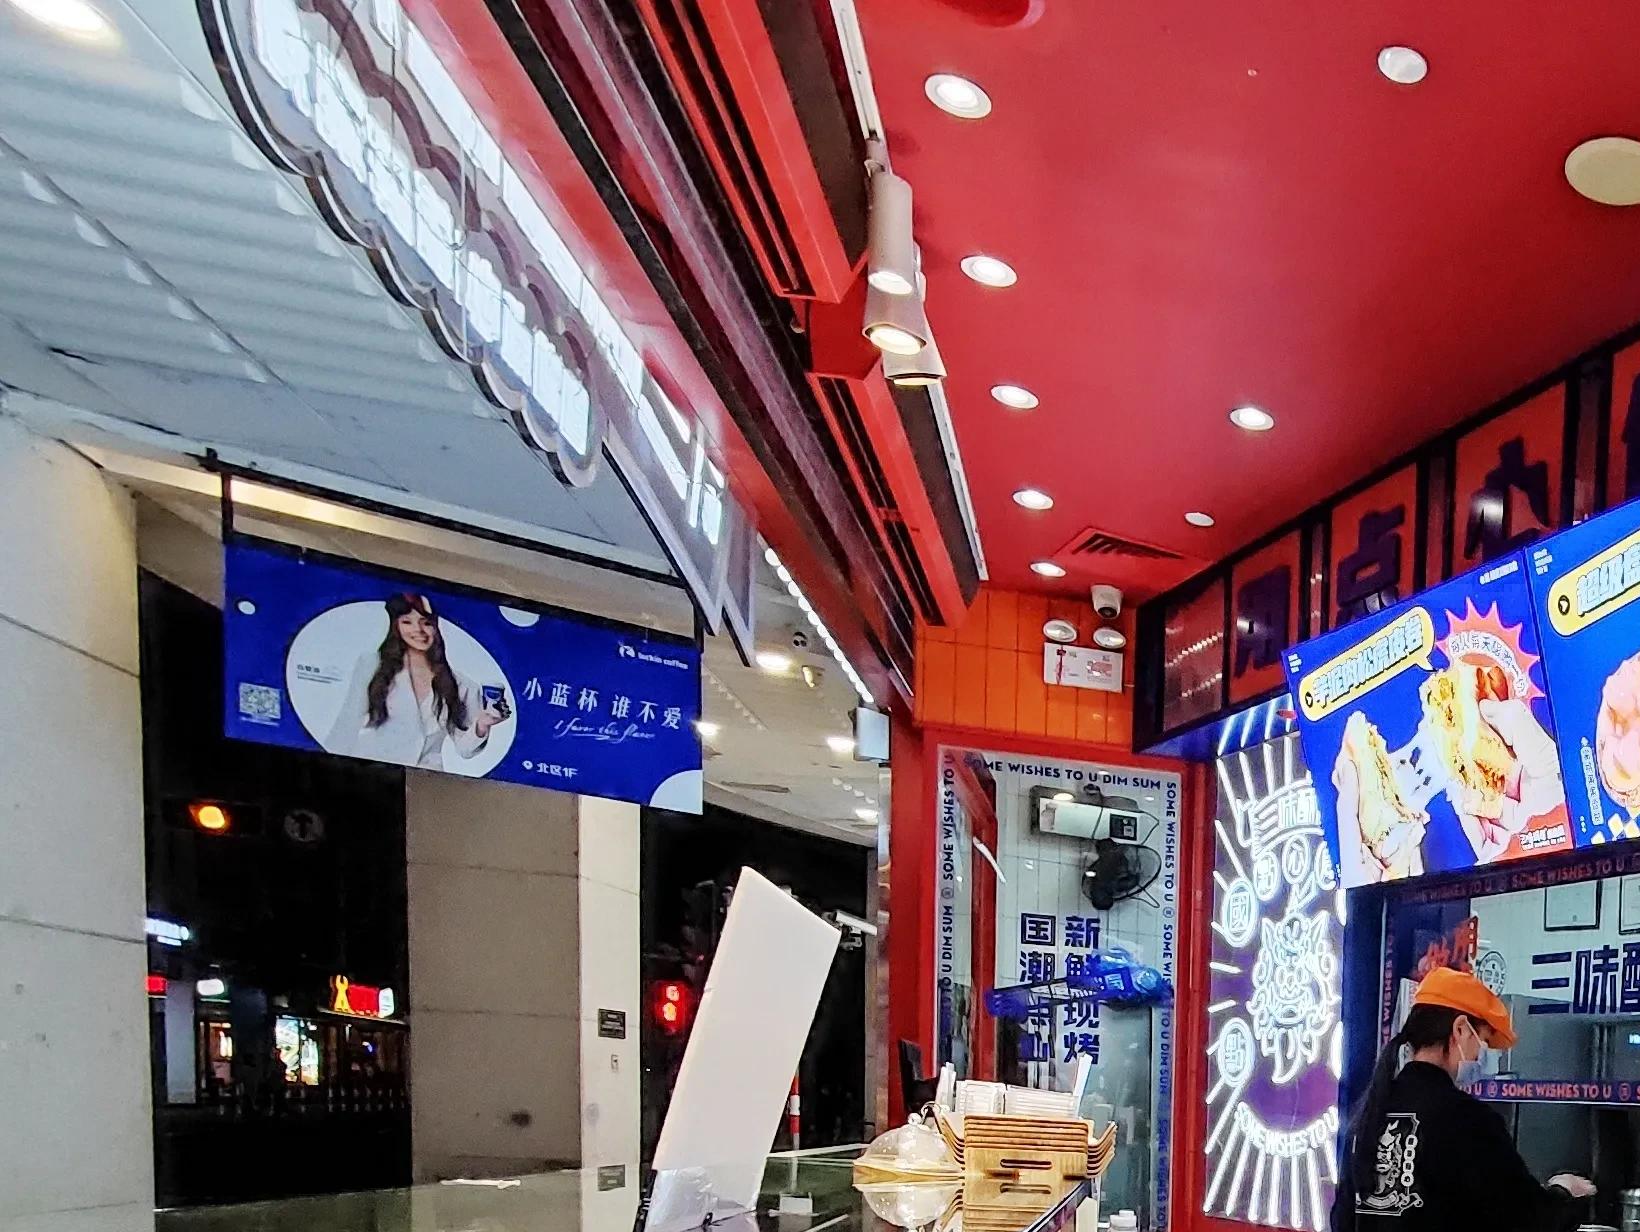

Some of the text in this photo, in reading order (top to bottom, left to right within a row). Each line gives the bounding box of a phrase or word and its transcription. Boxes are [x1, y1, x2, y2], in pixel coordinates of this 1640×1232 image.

[522, 677, 682, 730] 小蓝杯 谁不爱
[1008, 763, 1161, 790] WISHES TO U DIM SUM
[943, 793, 954, 839] WISHES
[1166, 782, 1176, 818] SOME
[943, 841, 954, 880] SOME
[1165, 820, 1175, 870] WISHES
[1164, 873, 1174, 890] TO
[1547, 866, 1597, 885] WISHES
[941, 905, 953, 933] SUM
[941, 936, 953, 960] DIM
[1163, 923, 1173, 959] SOME
[1502, 1083, 1612, 1099] SOME WISHES TO U
